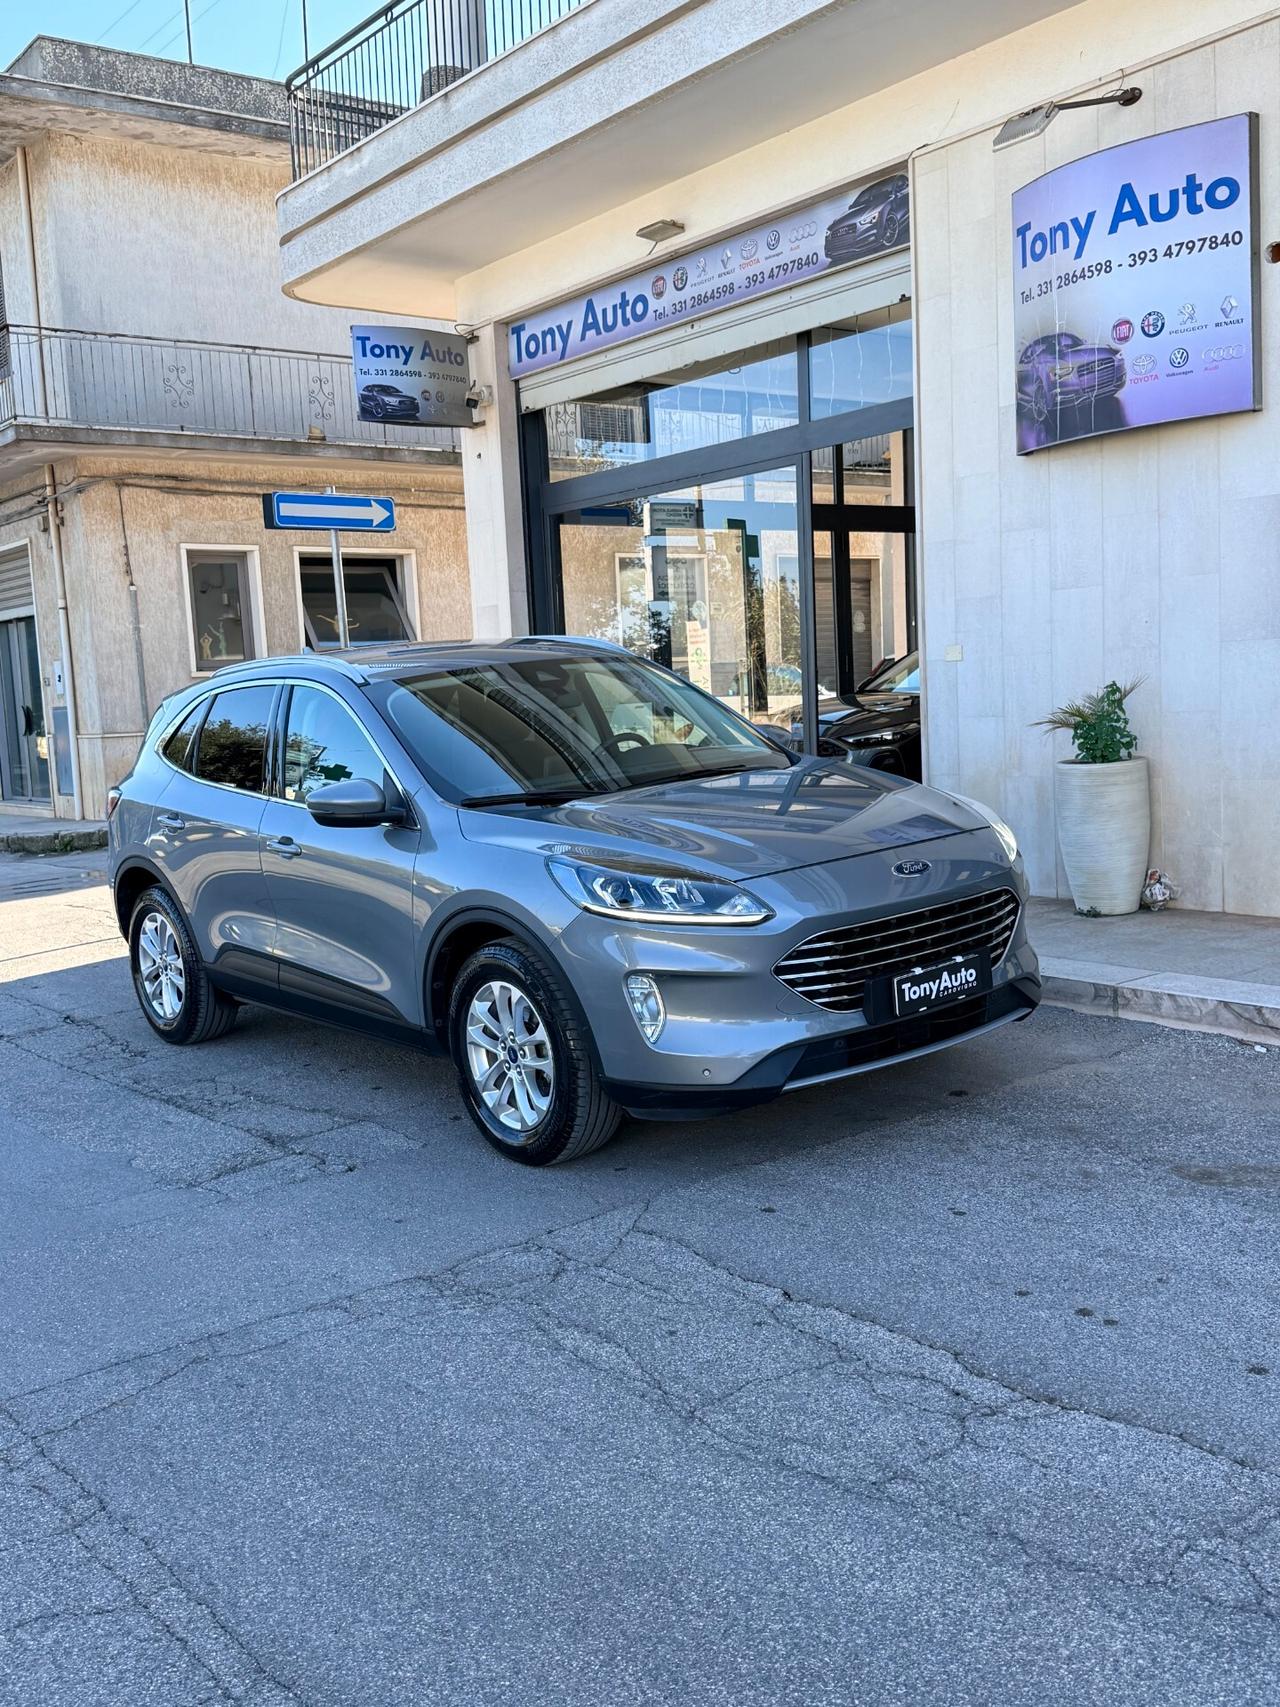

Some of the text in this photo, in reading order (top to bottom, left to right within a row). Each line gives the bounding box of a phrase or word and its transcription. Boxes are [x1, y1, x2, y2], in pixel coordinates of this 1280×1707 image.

[1016, 173, 1240, 269] Tony Auto
[1020, 288, 1035, 305] Tel.
[1037, 279, 1053, 297] 331
[1056, 259, 1113, 290] 2864598
[1128, 248, 1158, 268] 393
[1163, 230, 1243, 259] 4797840
[653, 306, 669, 321] Tel.
[671, 299, 687, 315] 331
[690, 282, 735, 309] 2864598
[745, 271, 765, 289] 393
[768, 252, 819, 280] 4797840
[511, 291, 649, 364] Tony Auto
[1169, 323, 1209, 336] PEUGEOT
[1214, 318, 1244, 328] RENAULT
[356, 335, 465, 367] Tony Auto
[359, 368, 373, 376] Tel.
[390, 369, 422, 378] 2864598
[1129, 374, 1159, 385] TOYOTA
[902, 862, 926, 874] Ford
[901, 967, 977, 1002] TonyAuto
